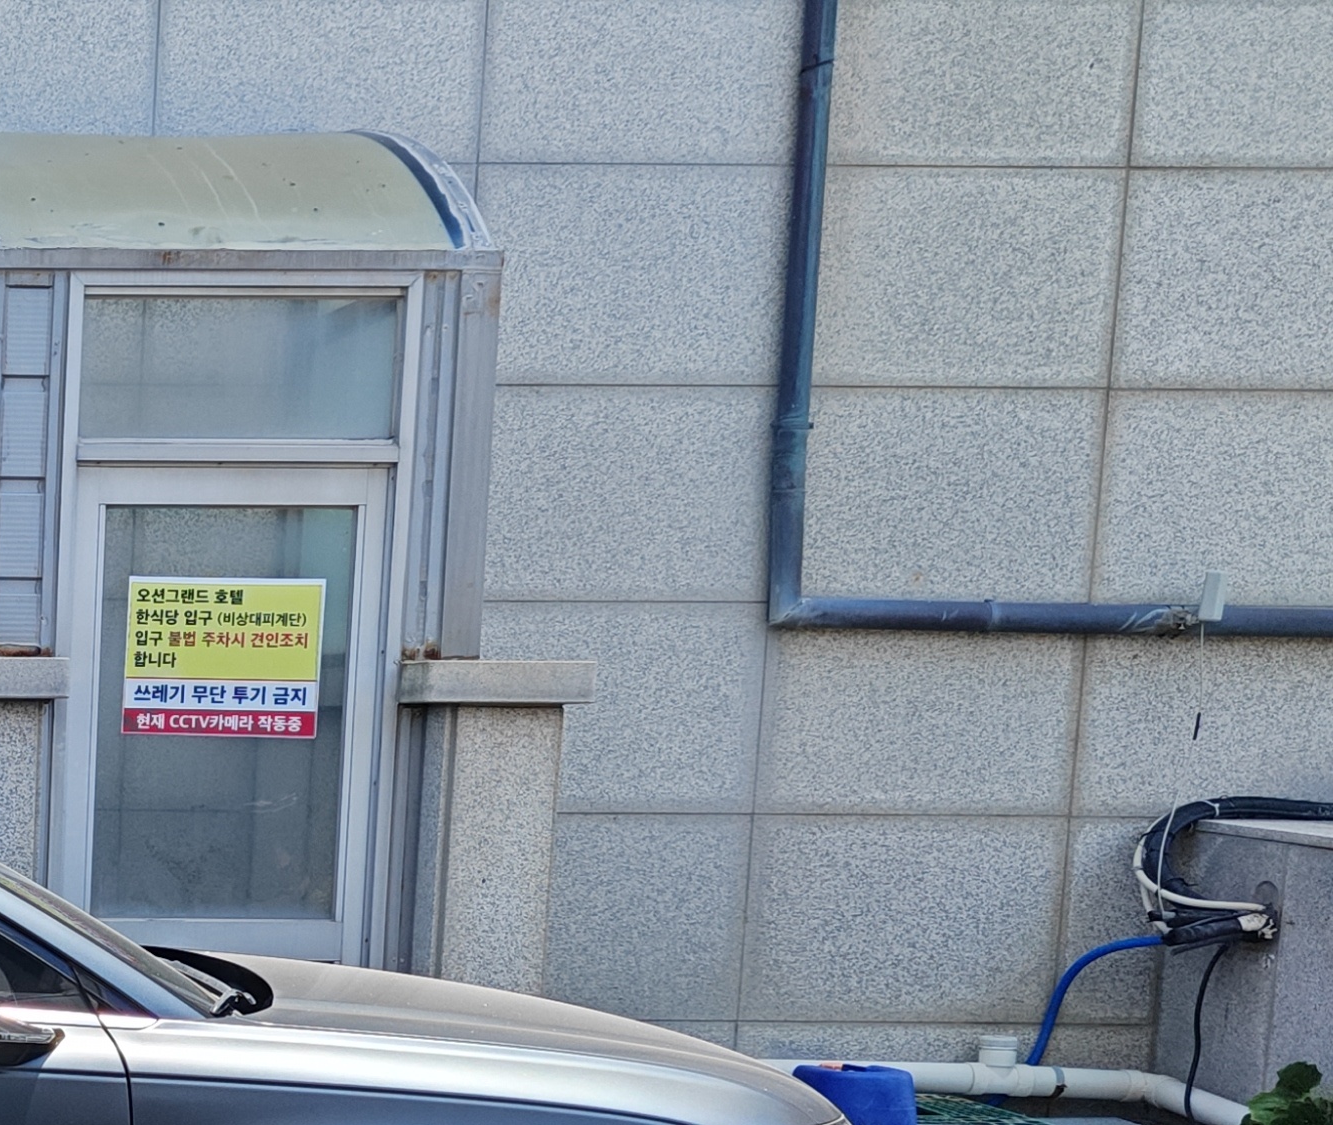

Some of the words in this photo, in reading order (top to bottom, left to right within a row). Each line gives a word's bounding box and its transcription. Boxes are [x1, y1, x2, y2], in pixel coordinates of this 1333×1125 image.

[136, 588, 209, 603] 오션그랜드
[213, 589, 244, 605] 호텔
[136, 609, 179, 625] 한식당
[184, 610, 213, 626] 입구
[217, 612, 307, 627] (비상대피계단)
[135, 630, 163, 647] 입구
[168, 631, 196, 647] 불법
[202, 632, 245, 648] 주차시
[250, 633, 309, 649] 견인조치
[133, 651, 177, 668] 합니다
[134, 685, 185, 703] 쓰레기
[191, 686, 227, 704] 무단
[232, 686, 266, 705] 투기
[272, 687, 307, 706] 금지
[136, 713, 165, 730] 현재
[169, 715, 254, 731] CCTV카메라
[258, 716, 302, 732] 작동중
